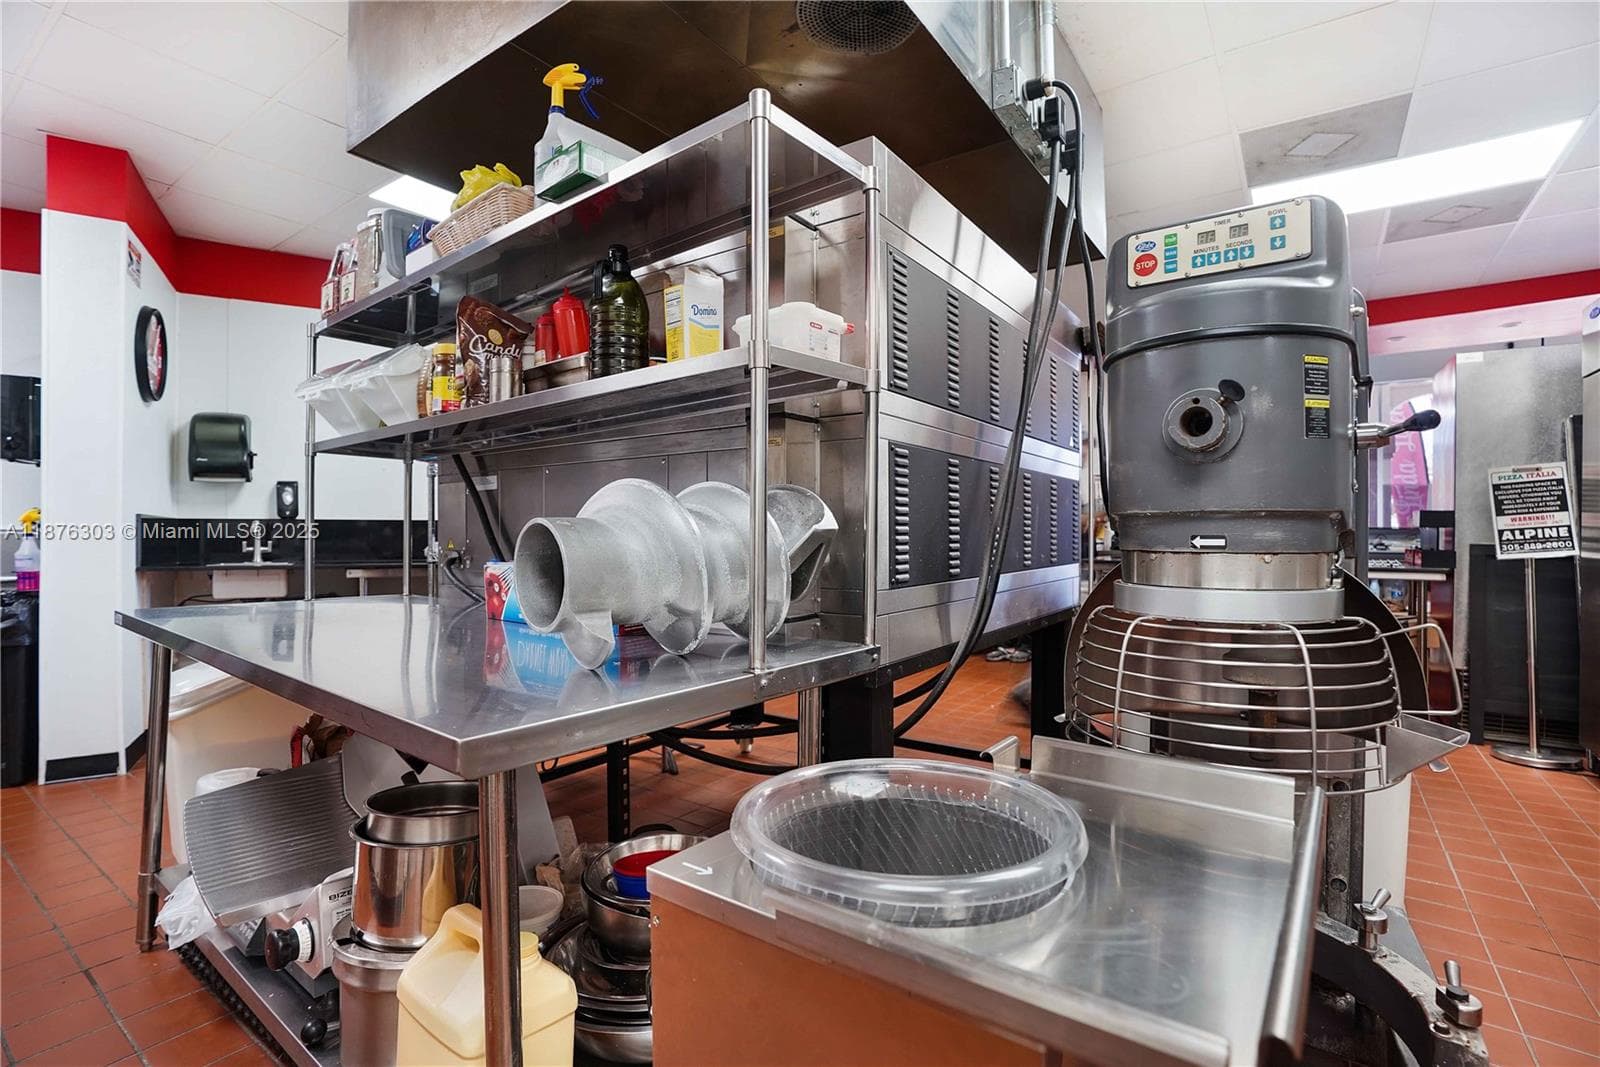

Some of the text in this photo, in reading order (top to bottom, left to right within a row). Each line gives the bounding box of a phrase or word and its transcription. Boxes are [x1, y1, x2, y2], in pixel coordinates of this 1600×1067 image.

[1267, 208, 1288, 216] BOWL
[1214, 218, 1232, 226] TIMER
[1193, 238, 1253, 254] MINUTES SECONDS
[1135, 259, 1156, 271] STOP
[691, 304, 718, 316] Domino
[469, 334, 522, 360] Candy
[1526, 471, 1557, 479] ITALIA
[1510, 514, 1555, 522] WARNING!!!
[1502, 527, 1569, 540] ALPINE
